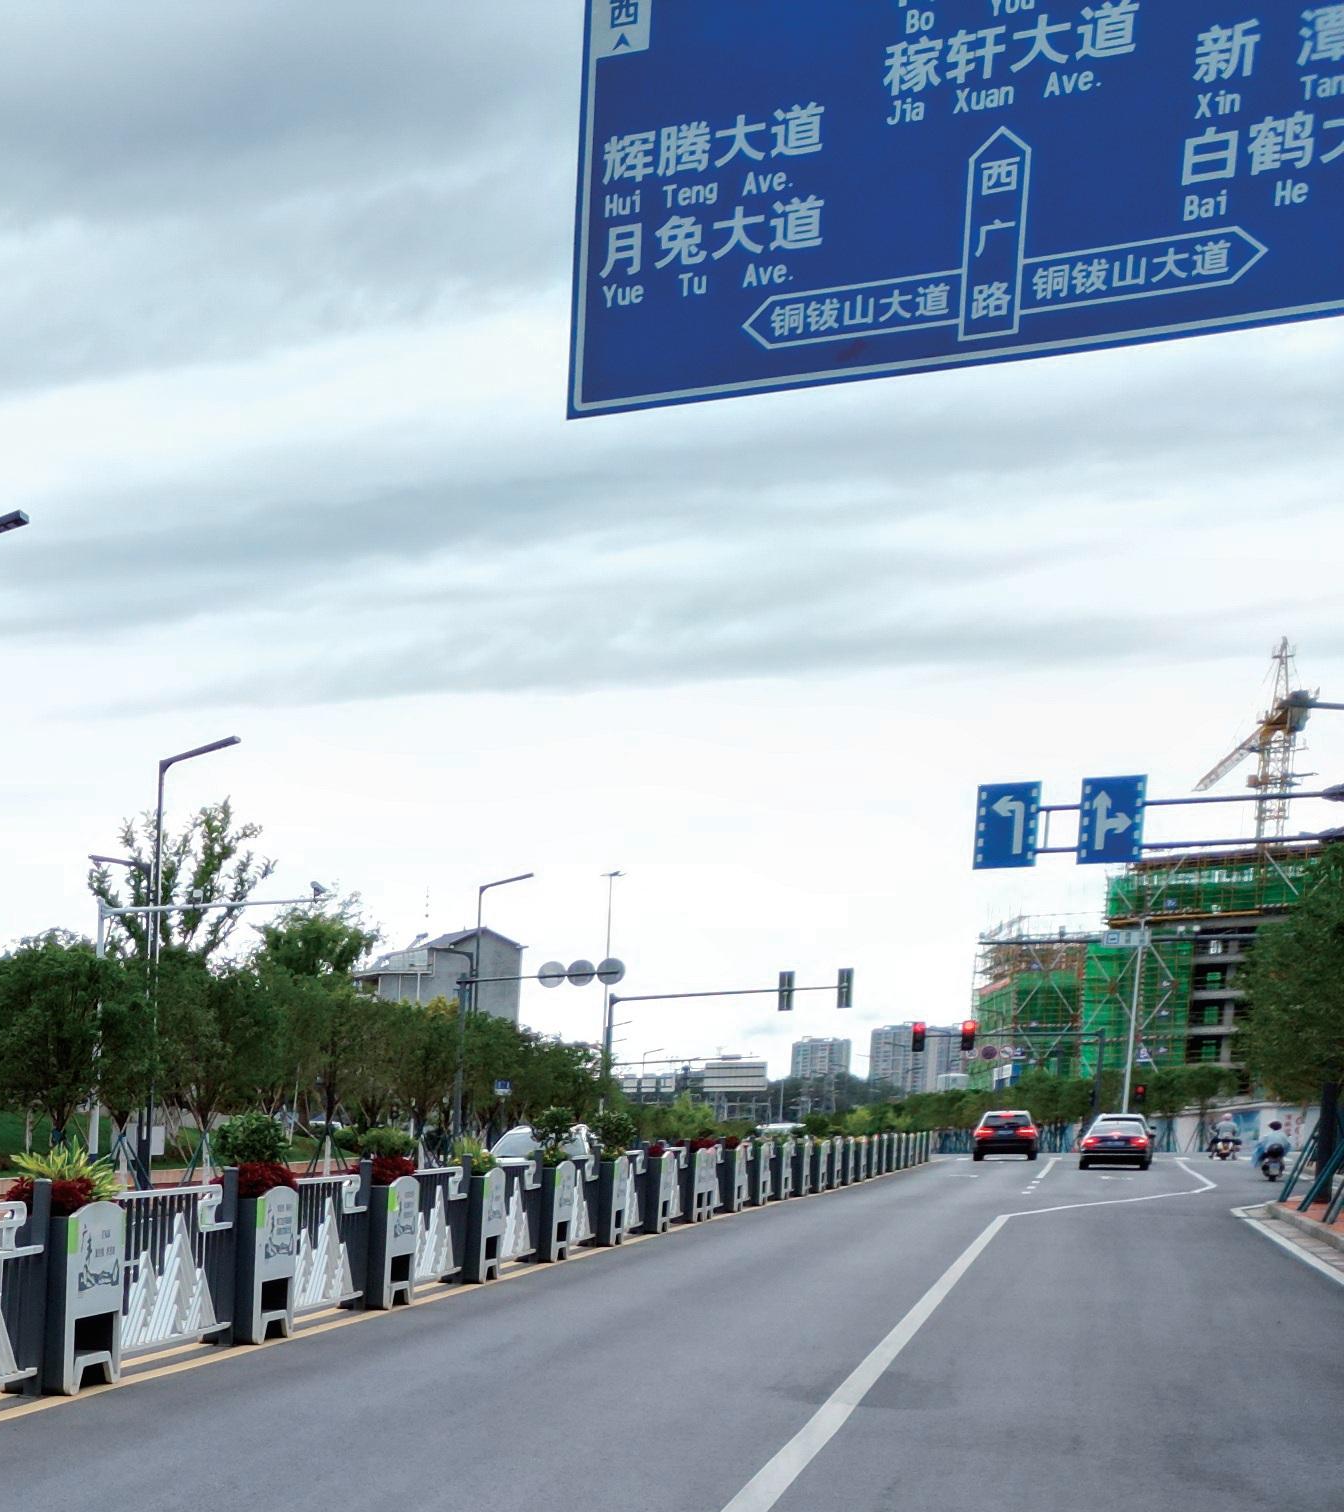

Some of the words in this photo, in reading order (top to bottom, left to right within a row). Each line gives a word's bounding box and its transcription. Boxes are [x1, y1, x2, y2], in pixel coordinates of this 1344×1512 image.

[883, 0, 1140, 96] 稼轩大道
[905, 9, 935, 34] Bo
[886, 98, 925, 125] Jia
[952, 85, 1014, 114] Xuan
[1043, 70, 1102, 98] Ave.
[1194, 90, 1241, 119] Xin
[603, 102, 825, 185] 辉腾大道
[604, 189, 641, 218] Hui
[663, 182, 718, 208] Teng
[742, 171, 794, 196] Ave.
[1183, 189, 1227, 221] Bai
[1274, 179, 1309, 206] He
[599, 194, 825, 279] 月兔大道
[971, 156, 1020, 320] 西广路
[603, 284, 644, 308] Yue
[678, 272, 707, 297] Tu
[742, 263, 794, 288] Ave.
[1032, 239, 1231, 300] 铜钹山大道
[770, 282, 950, 337] 铜钹山大道
